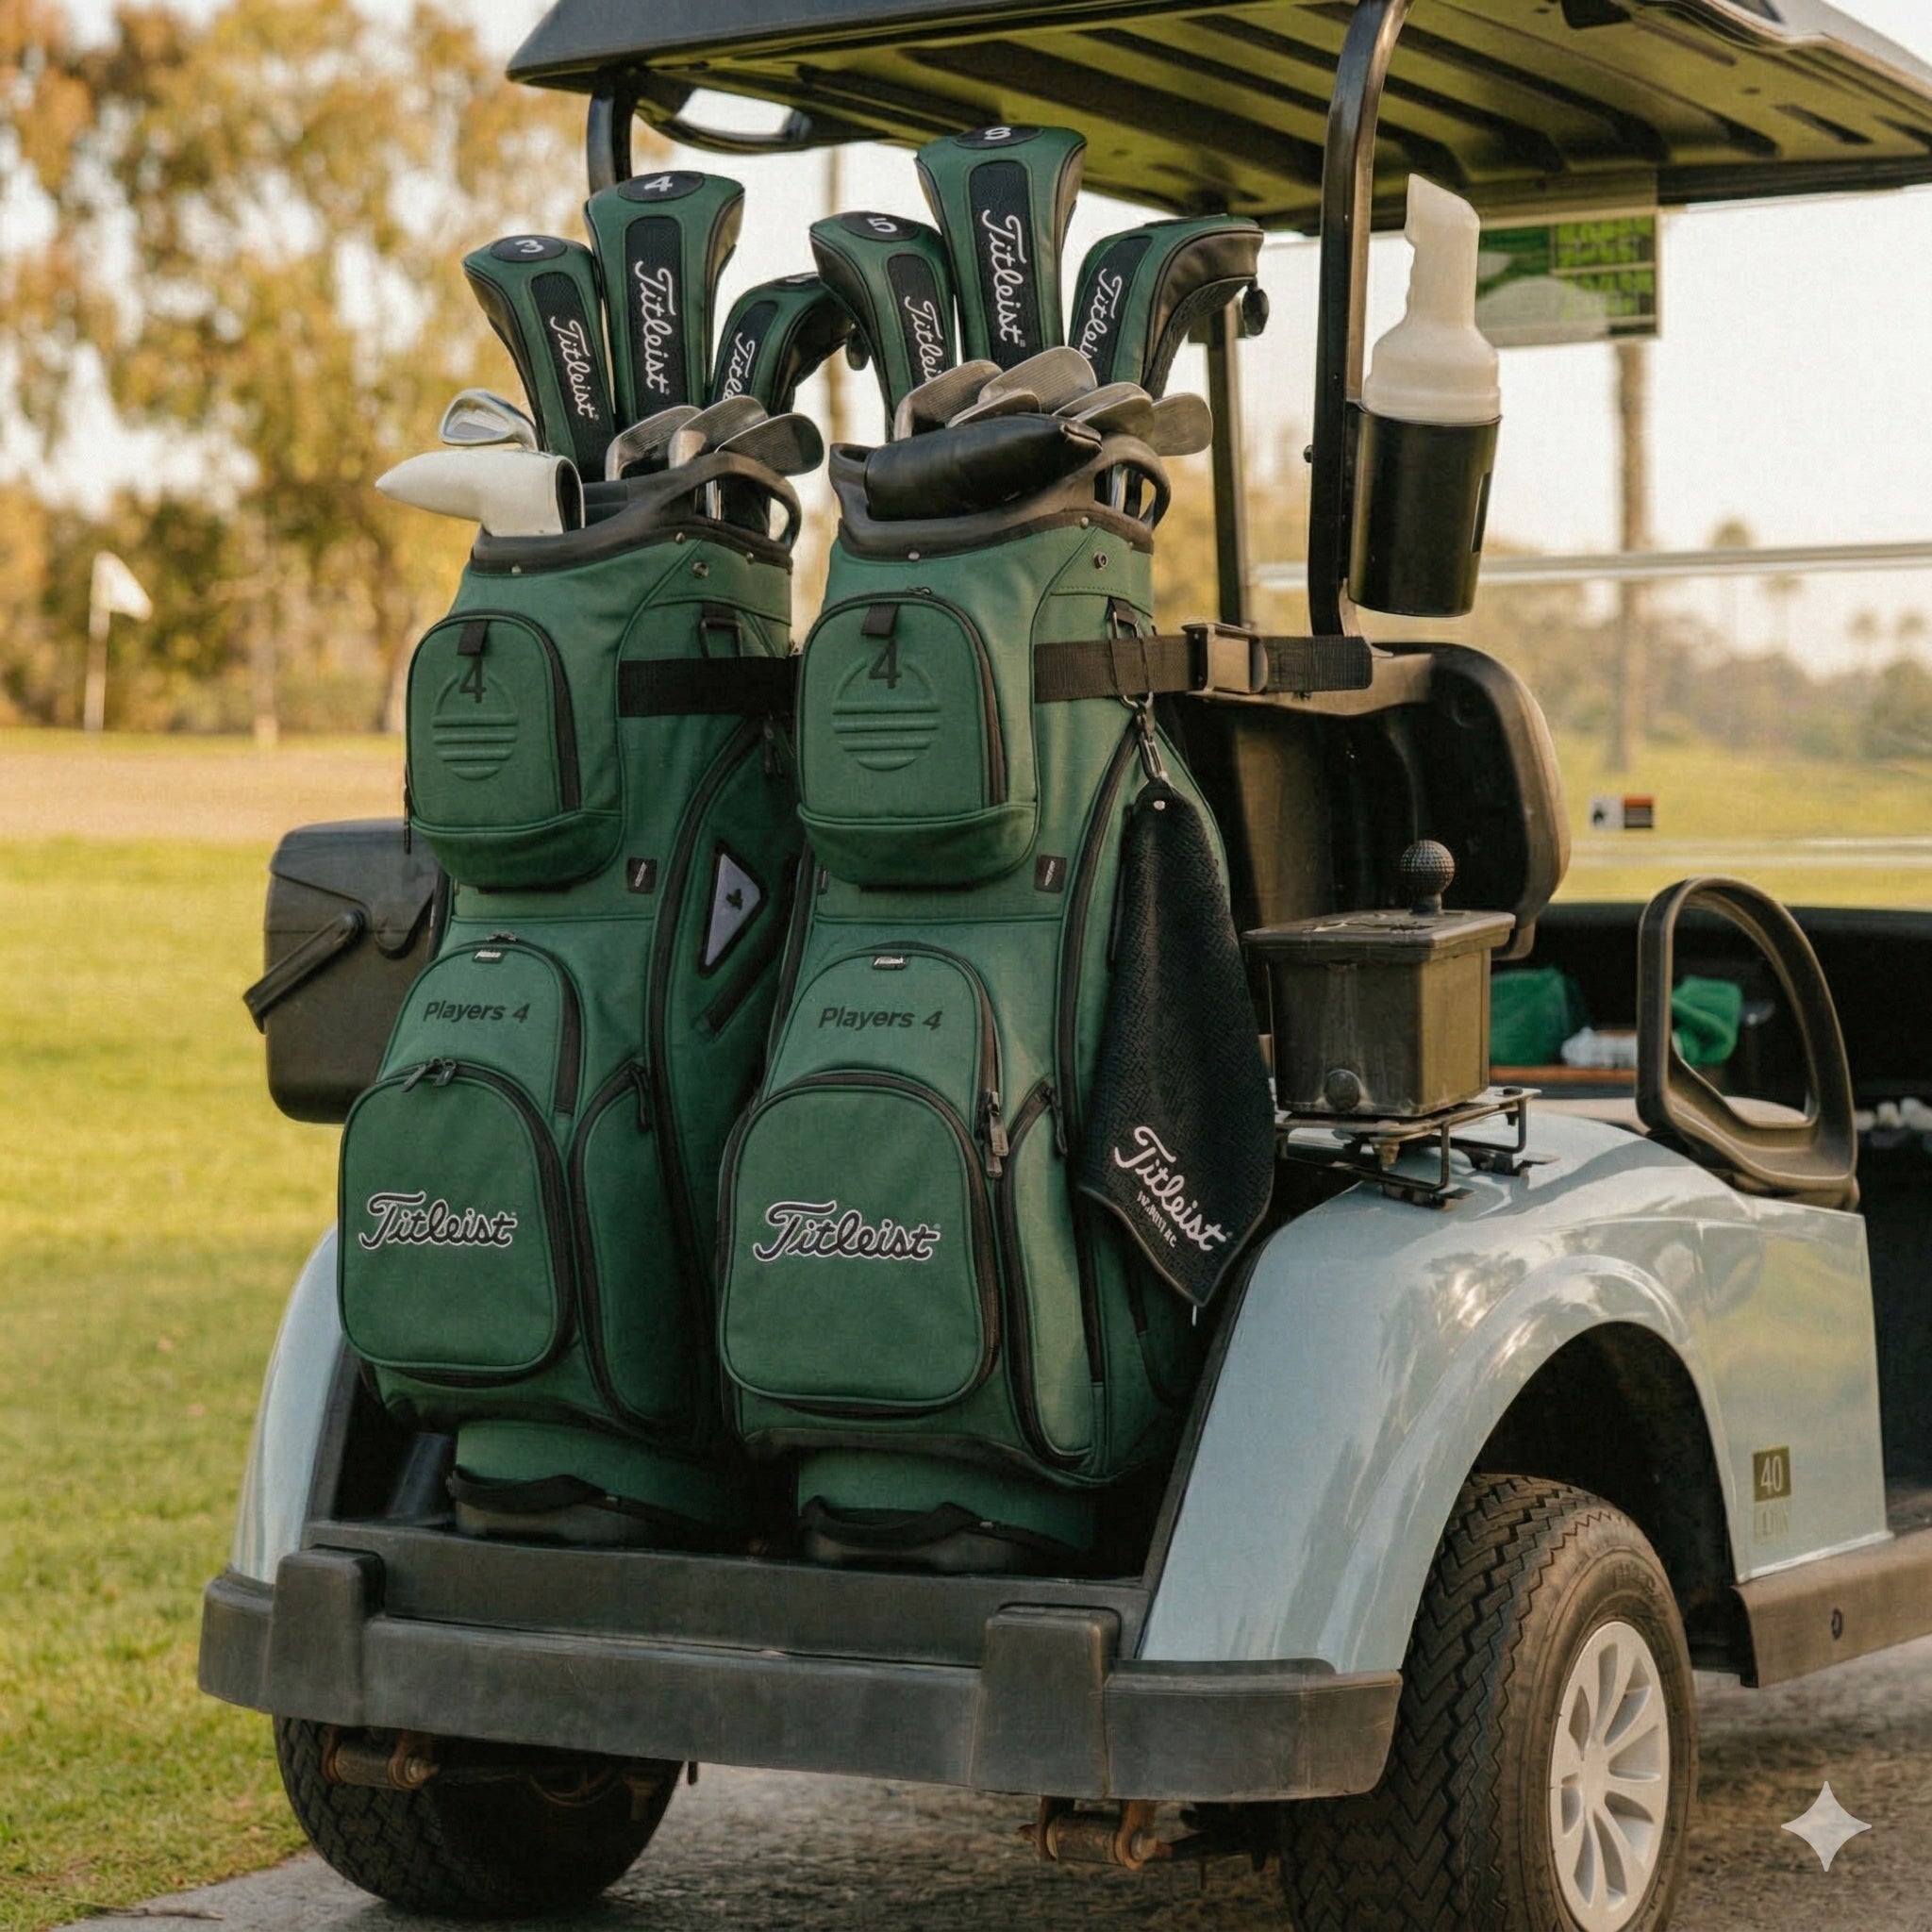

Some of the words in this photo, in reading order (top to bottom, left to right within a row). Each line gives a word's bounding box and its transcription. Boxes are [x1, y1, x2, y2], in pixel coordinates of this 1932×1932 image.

[643, 176, 673, 192] 4
[515, 240, 544, 253] 3
[867, 217, 898, 233] 5
[981, 208, 1026, 344] Titleist
[635, 260, 676, 393] Titleist
[904, 295, 943, 382] Titlei
[1079, 268, 1123, 358] Titlei
[550, 316, 595, 419] Titleist
[722, 332, 755, 400] Title
[459, 654, 487, 704] 4
[869, 639, 902, 690] 4
[423, 1000, 507, 1023] Players
[512, 1003, 530, 1024] 4
[818, 1006, 916, 1031] Players
[922, 1010, 943, 1031] 4
[1114, 1125, 1227, 1251] Titleist
[358, 1191, 518, 1250] Titleist
[753, 1200, 941, 1262] Titleist
[1760, 1455, 1782, 1496] 40
